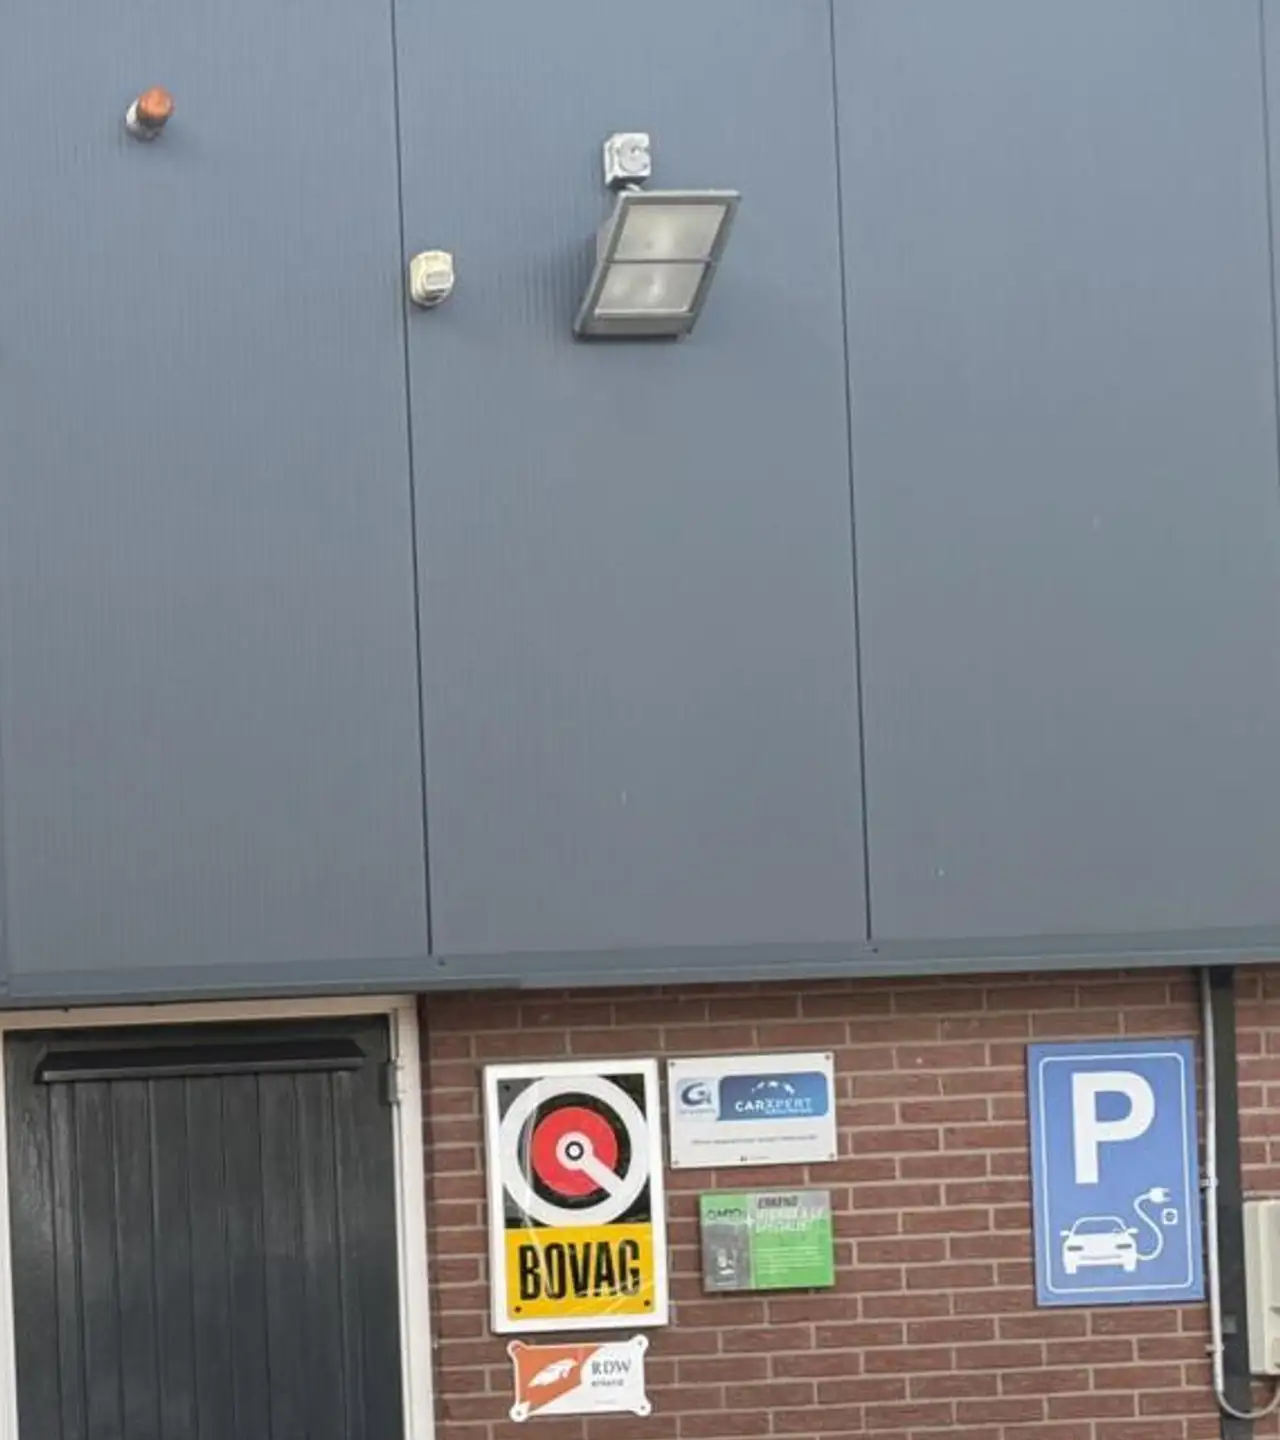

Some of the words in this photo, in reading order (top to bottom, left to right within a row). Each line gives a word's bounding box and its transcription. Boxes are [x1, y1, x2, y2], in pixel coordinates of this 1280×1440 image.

[1072, 1071, 1155, 1184] P
[518, 1239, 640, 1302] BOVAG
[591, 1359, 632, 1376] RDW
